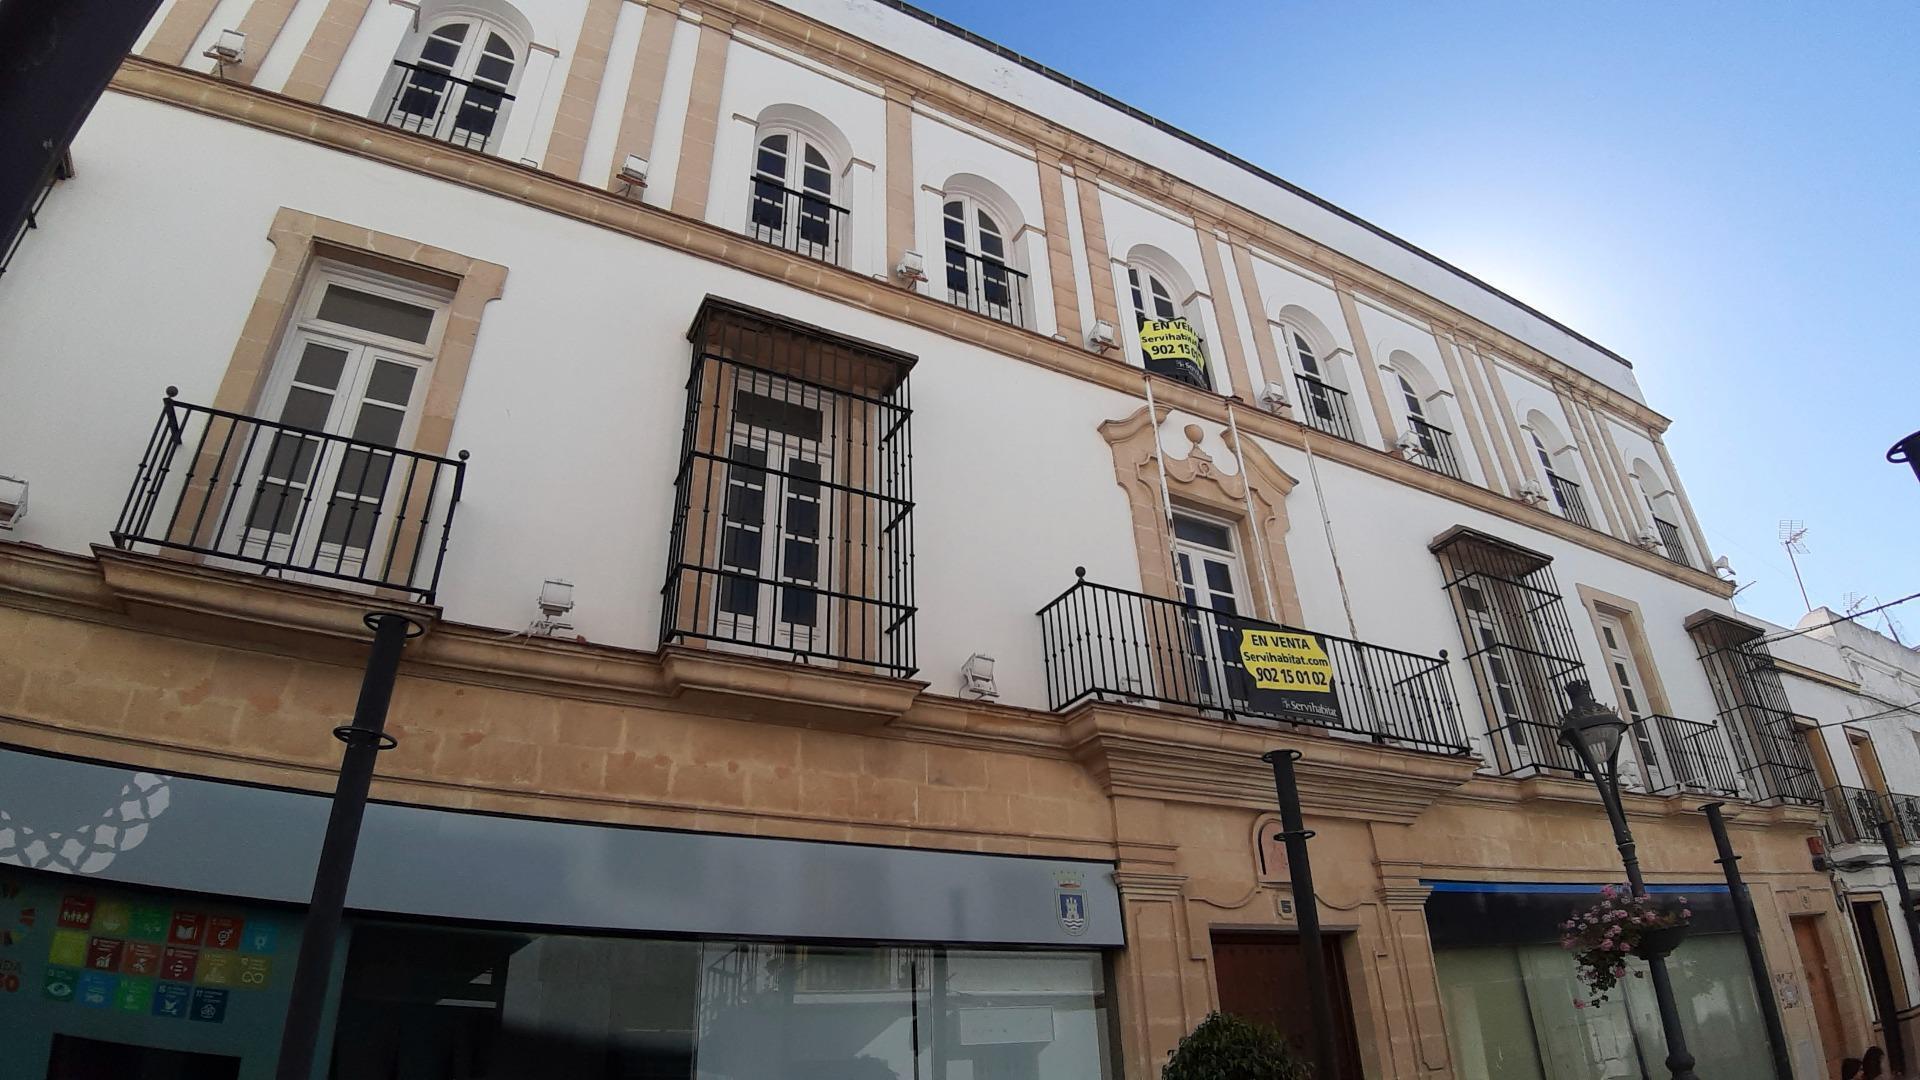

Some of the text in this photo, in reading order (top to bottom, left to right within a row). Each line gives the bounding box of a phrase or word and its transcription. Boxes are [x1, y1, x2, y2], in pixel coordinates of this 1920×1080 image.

[1152, 322, 1170, 331] EN
[1151, 345, 1175, 355] 902
[1178, 343, 1190, 354] 15
[1251, 634, 1311, 650] EN VENTA
[1243, 651, 1329, 667] Servihabitat.com
[1256, 667, 1328, 686] 902 15 01 02
[1291, 701, 1337, 717] Servihabitat
